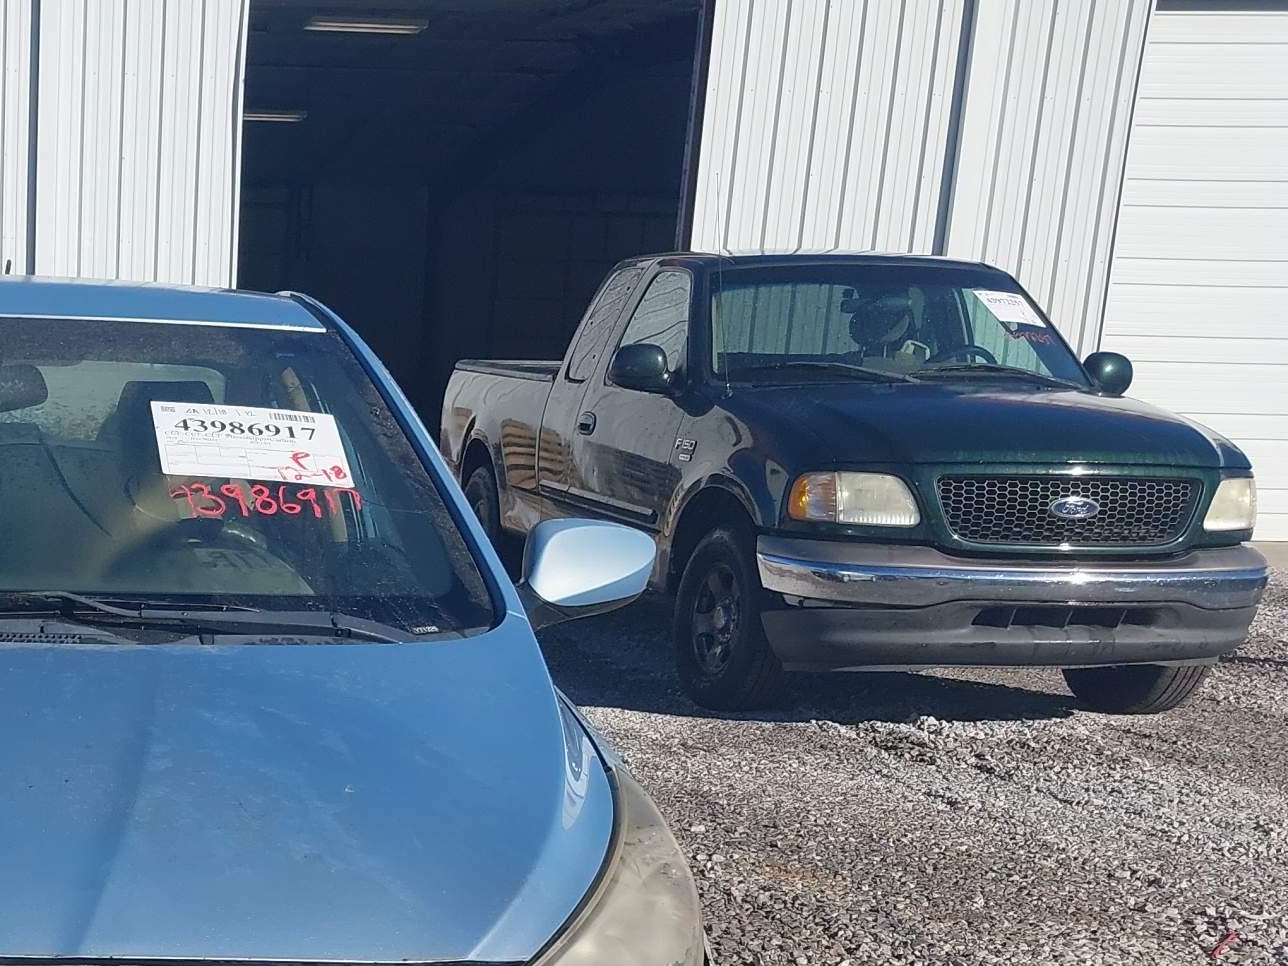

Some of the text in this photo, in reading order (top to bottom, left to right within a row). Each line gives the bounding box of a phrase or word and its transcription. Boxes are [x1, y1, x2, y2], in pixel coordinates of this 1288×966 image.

[174, 418, 316, 441] 43986917
[674, 438, 696, 449] F150
[1062, 503, 1090, 514] Ford
